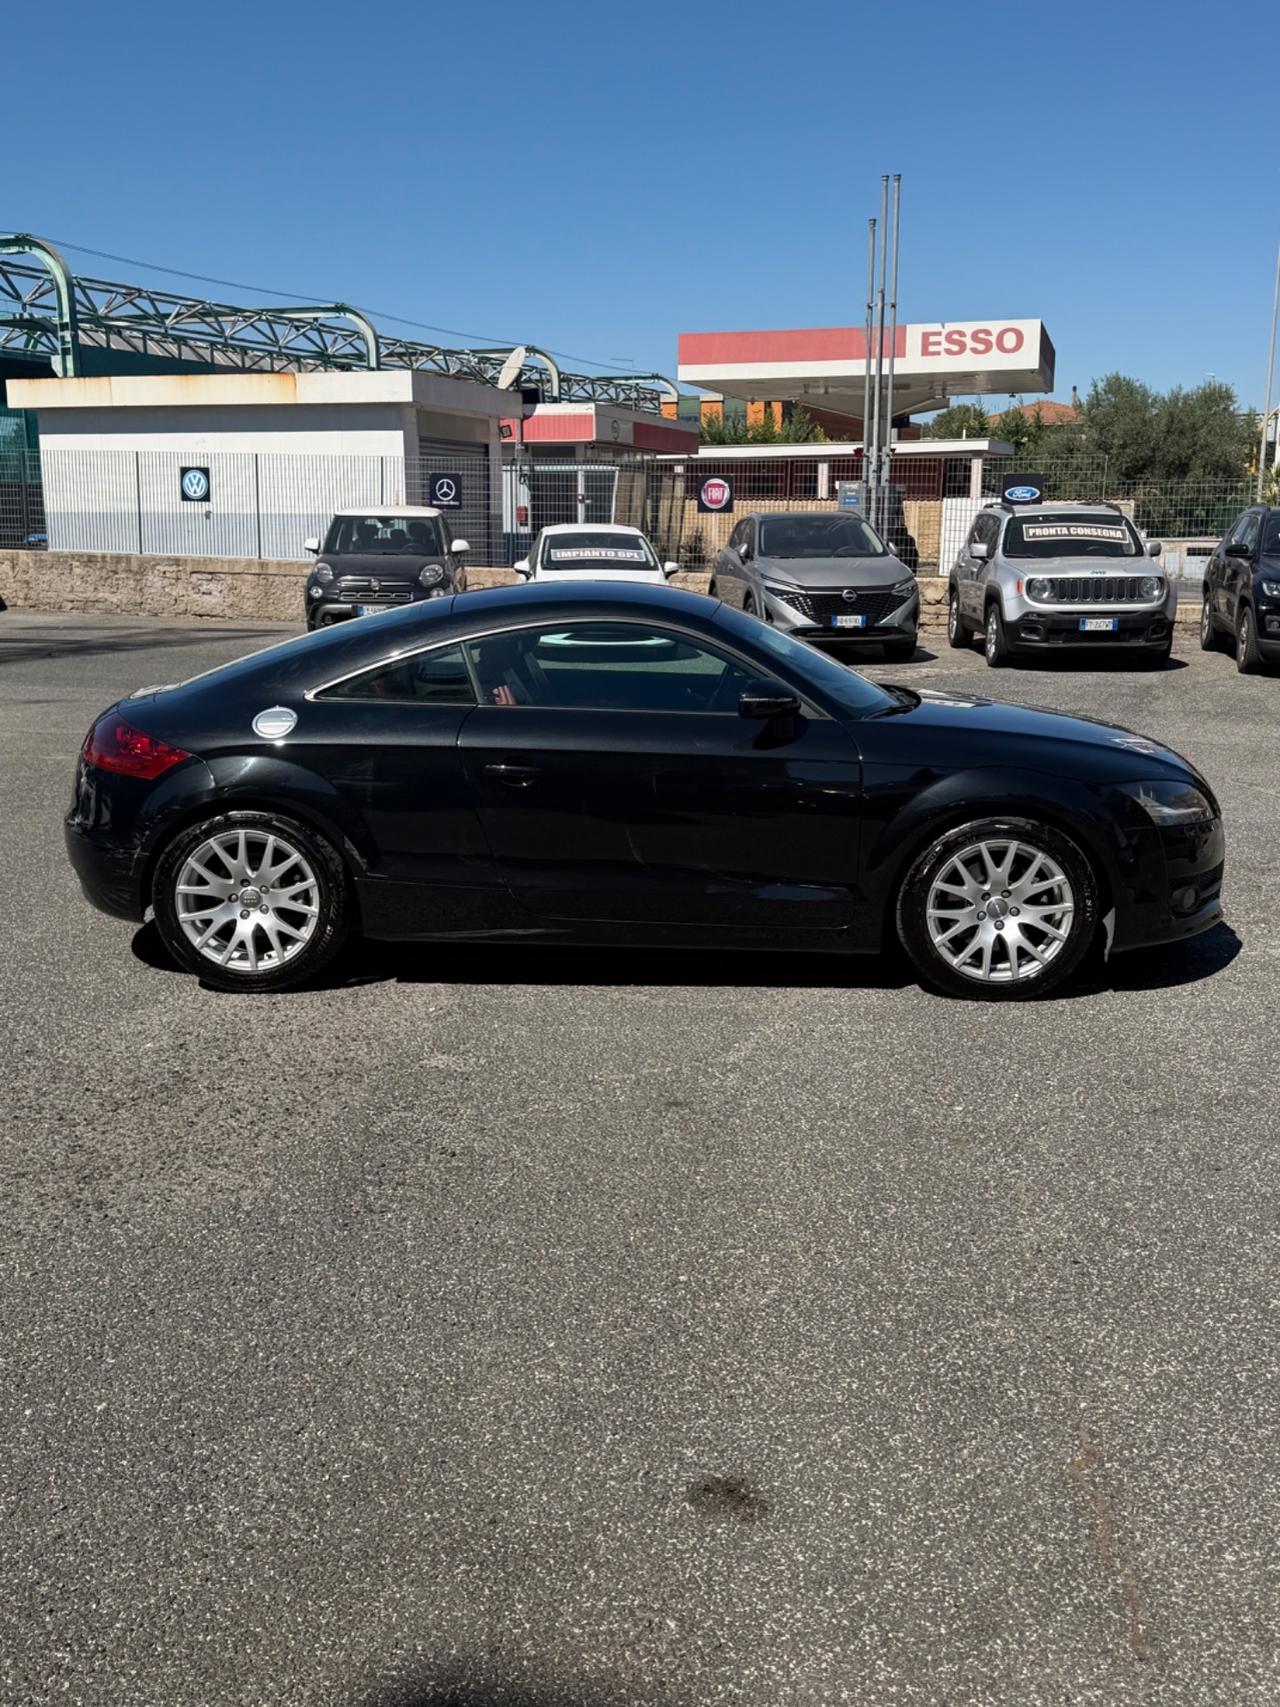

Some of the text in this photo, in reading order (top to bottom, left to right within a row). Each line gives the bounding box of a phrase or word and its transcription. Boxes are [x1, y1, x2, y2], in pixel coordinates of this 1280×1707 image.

[920, 327, 1025, 357] ESSO
[1028, 526, 1123, 538] PRONTA CONSEGNA
[556, 549, 640, 559] IMPIANTO GPL
